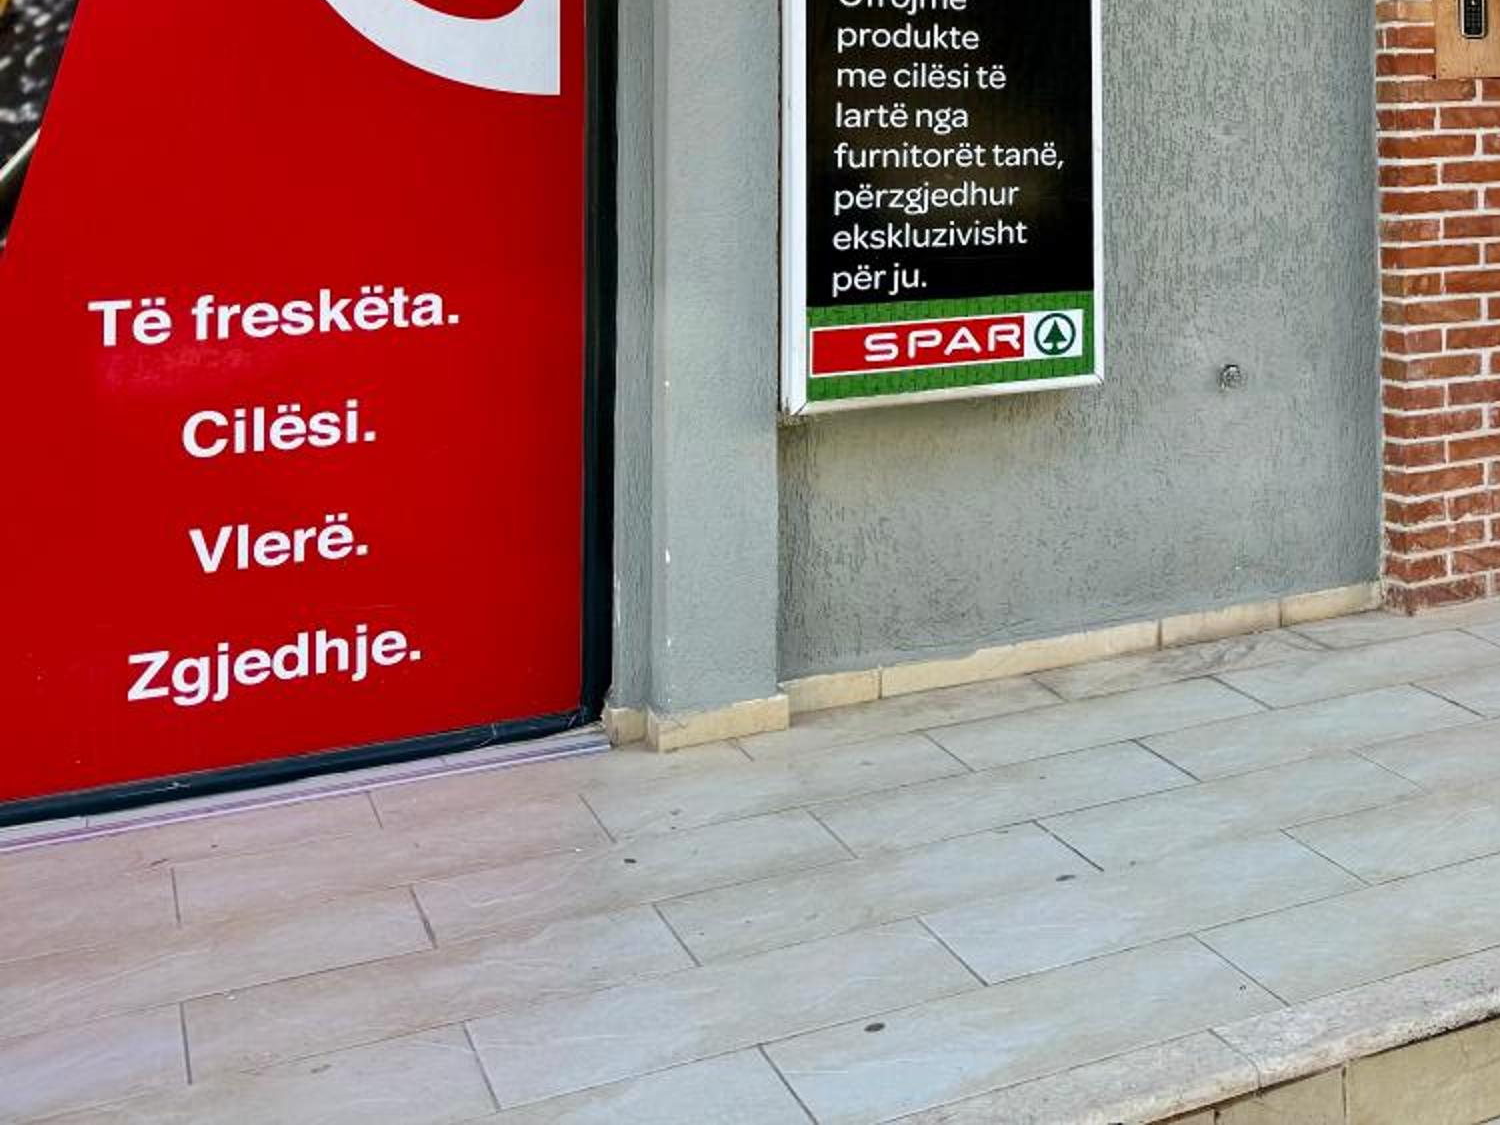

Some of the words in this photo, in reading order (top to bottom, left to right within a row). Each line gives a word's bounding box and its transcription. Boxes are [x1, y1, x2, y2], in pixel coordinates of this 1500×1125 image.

[837, 23, 980, 53] produkte
[837, 68, 887, 88] me
[894, 63, 970, 90] cilësi
[977, 65, 1007, 89] të
[836, 102, 908, 129] lartë
[916, 106, 969, 135] nga
[834, 142, 986, 169] furnitorët
[993, 142, 1065, 170] tanë,
[834, 182, 1020, 216] përzgjedhur
[833, 220, 1028, 251] ekskluzivisht
[832, 264, 886, 298] për
[888, 262, 928, 296] ju.
[88, 298, 172, 348] Të
[191, 285, 459, 341] freskëta.
[864, 322, 1022, 363] SPAR
[182, 399, 376, 459] Cilësi.
[189, 512, 369, 574] Vlerë.
[127, 624, 421, 706] Zgjedhje.
